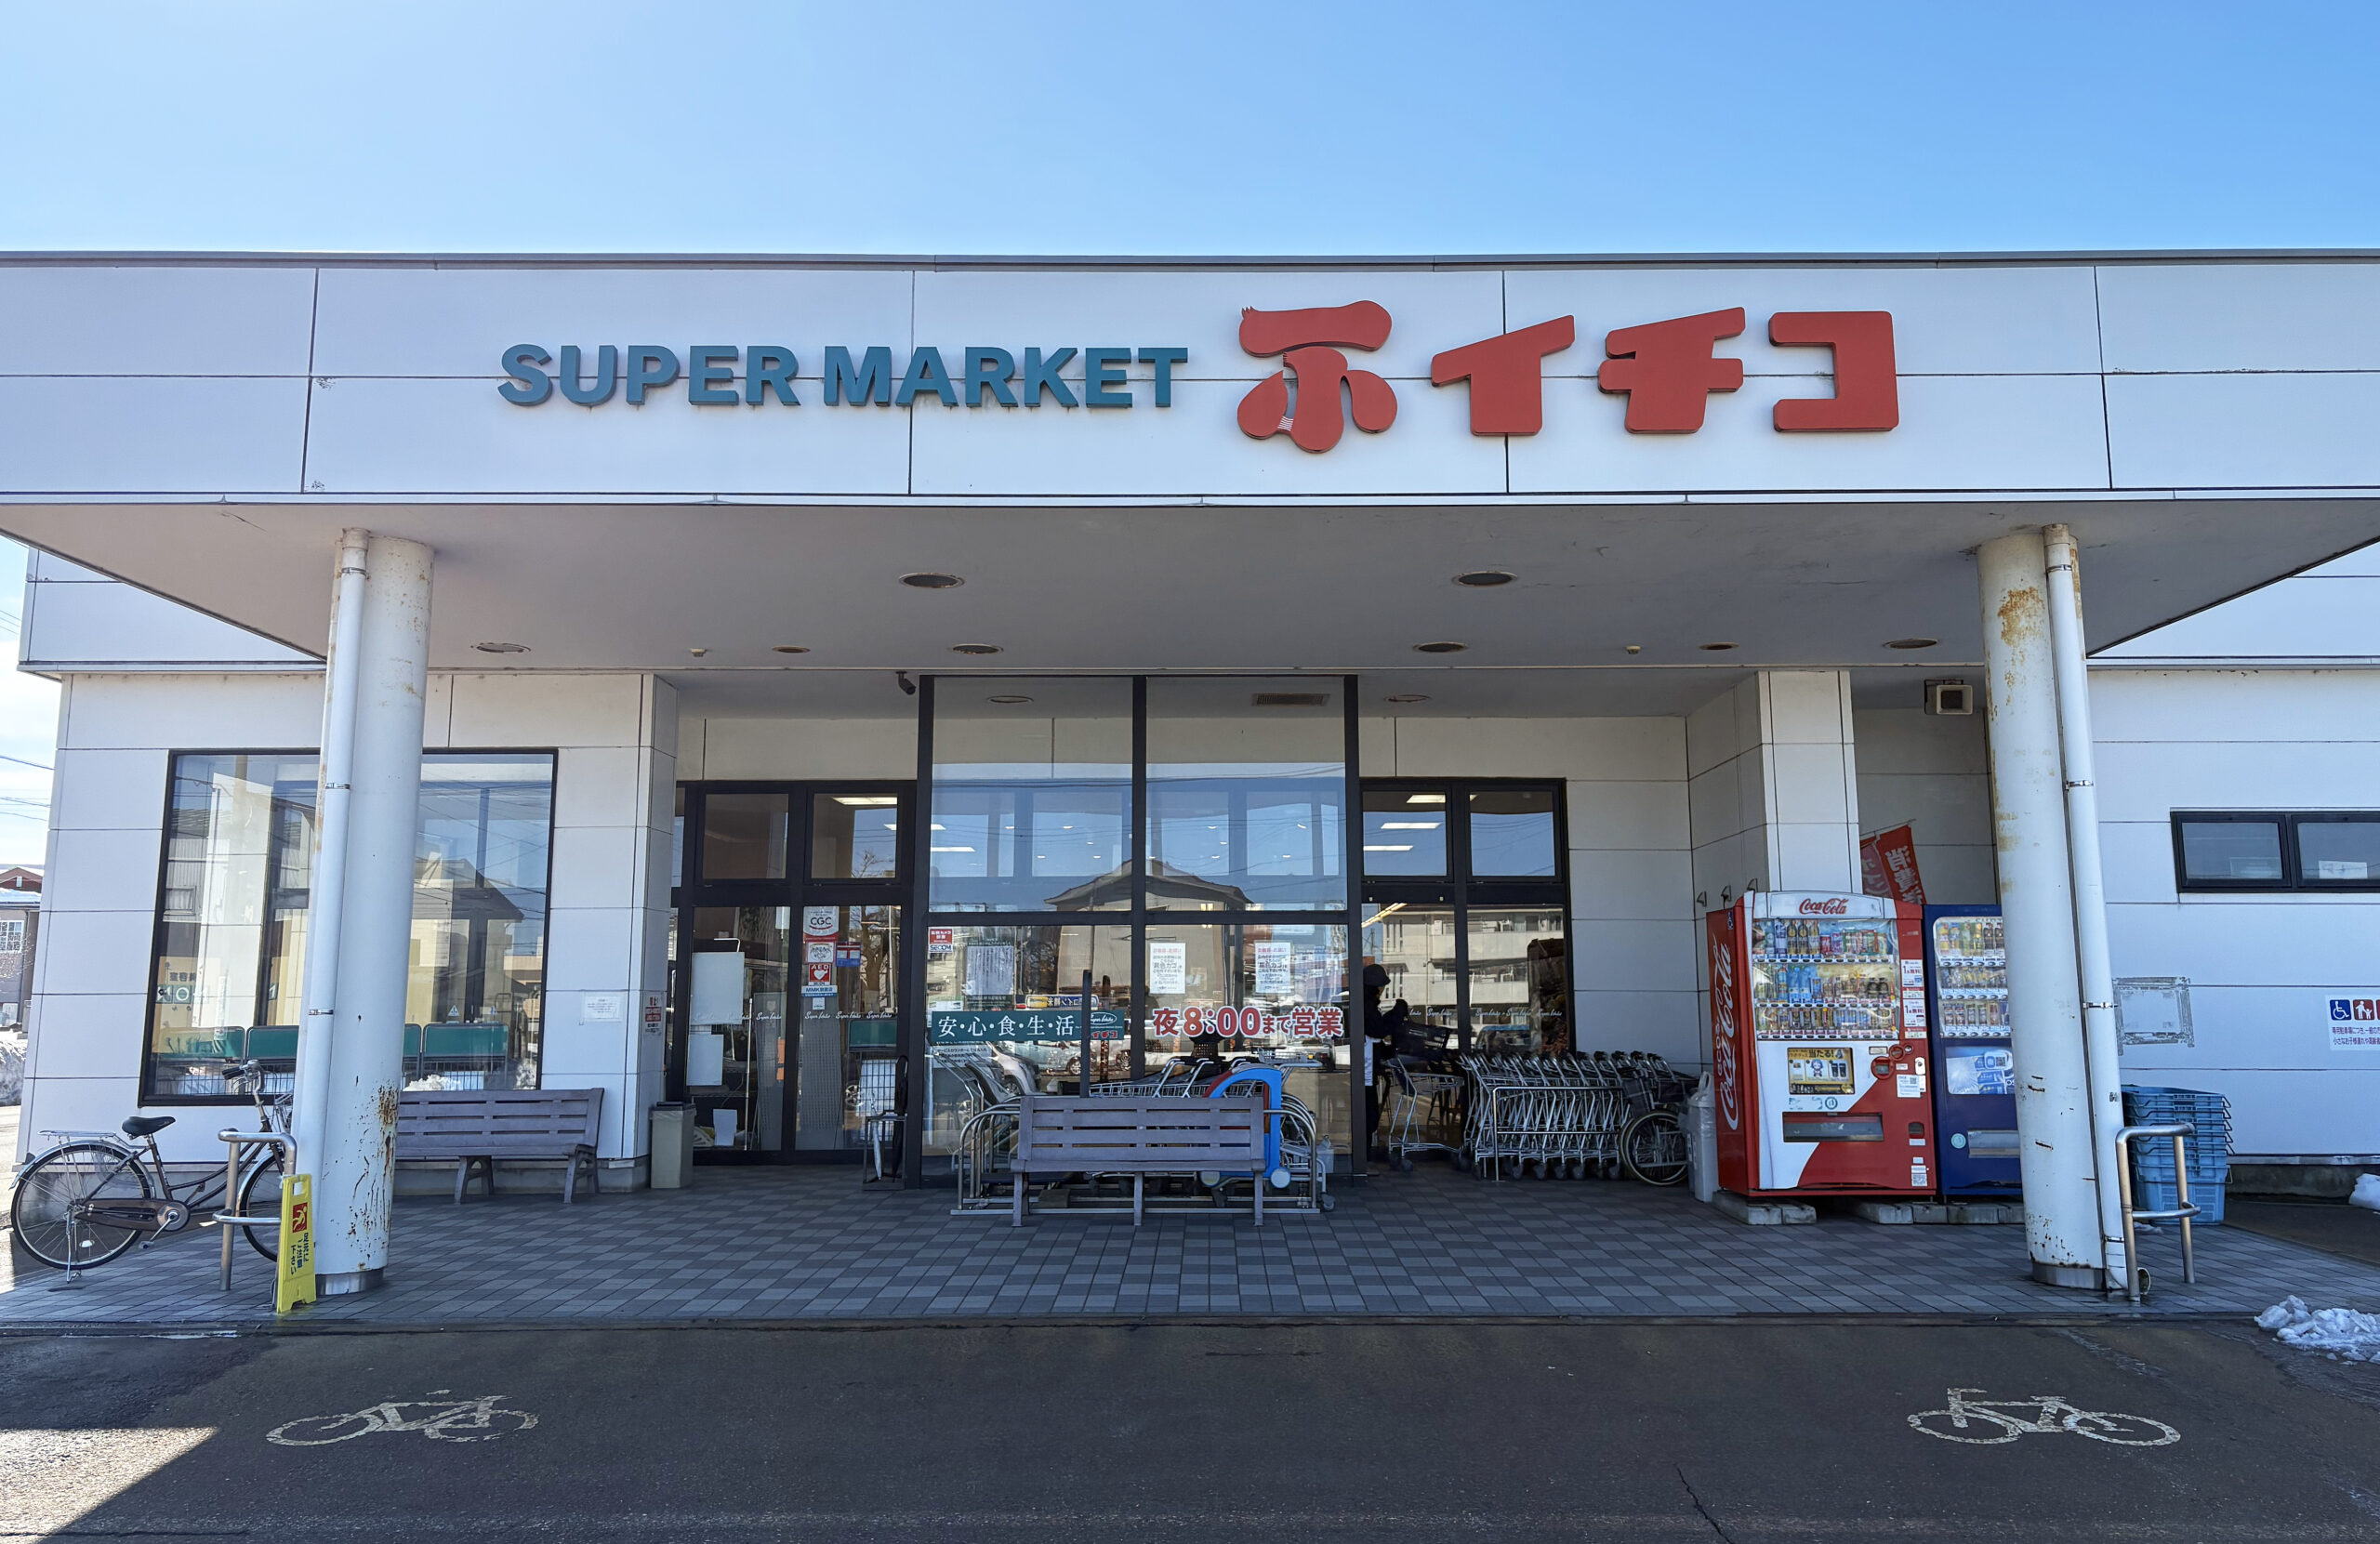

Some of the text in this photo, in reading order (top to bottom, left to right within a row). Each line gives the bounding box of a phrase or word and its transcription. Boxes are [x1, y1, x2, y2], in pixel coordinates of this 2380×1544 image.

[497, 343, 1189, 408] SUPER MARKET
[1798, 897, 1849, 915] Coca-Cola
[810, 917, 832, 925] CGC
[1153, 1006, 1344, 1037] 夜8:00まで営業
